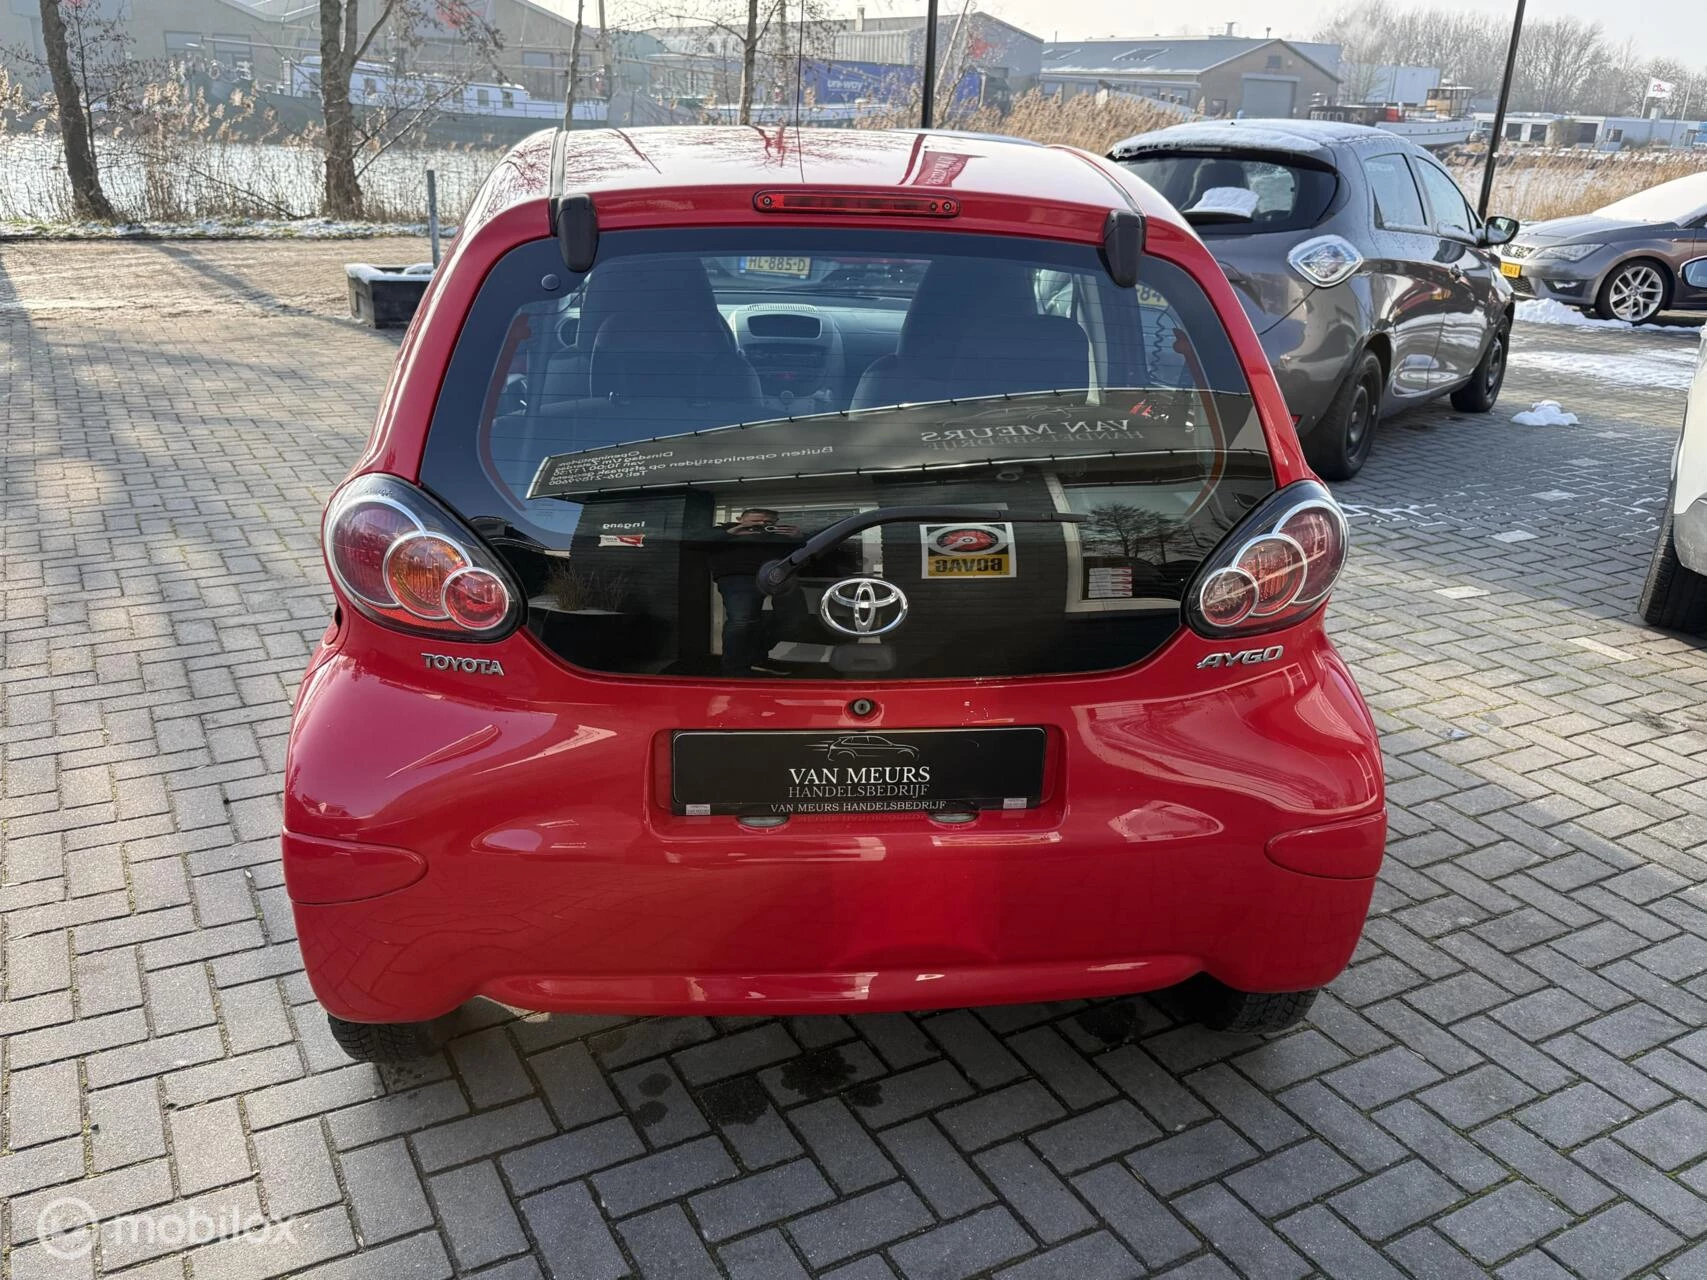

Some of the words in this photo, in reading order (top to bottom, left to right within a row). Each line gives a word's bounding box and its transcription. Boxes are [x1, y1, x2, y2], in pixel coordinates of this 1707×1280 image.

[421, 652, 504, 677] TOYOTA
[1197, 644, 1284, 670] AYGO
[788, 767, 840, 785] VAN
[846, 766, 931, 784] MEURS
[788, 784, 931, 799] HANDELSBEDRIJF
[770, 803, 794, 813] VAN
[798, 802, 840, 812] MEURS
[843, 800, 948, 811] HANDELSBEDRIJF
